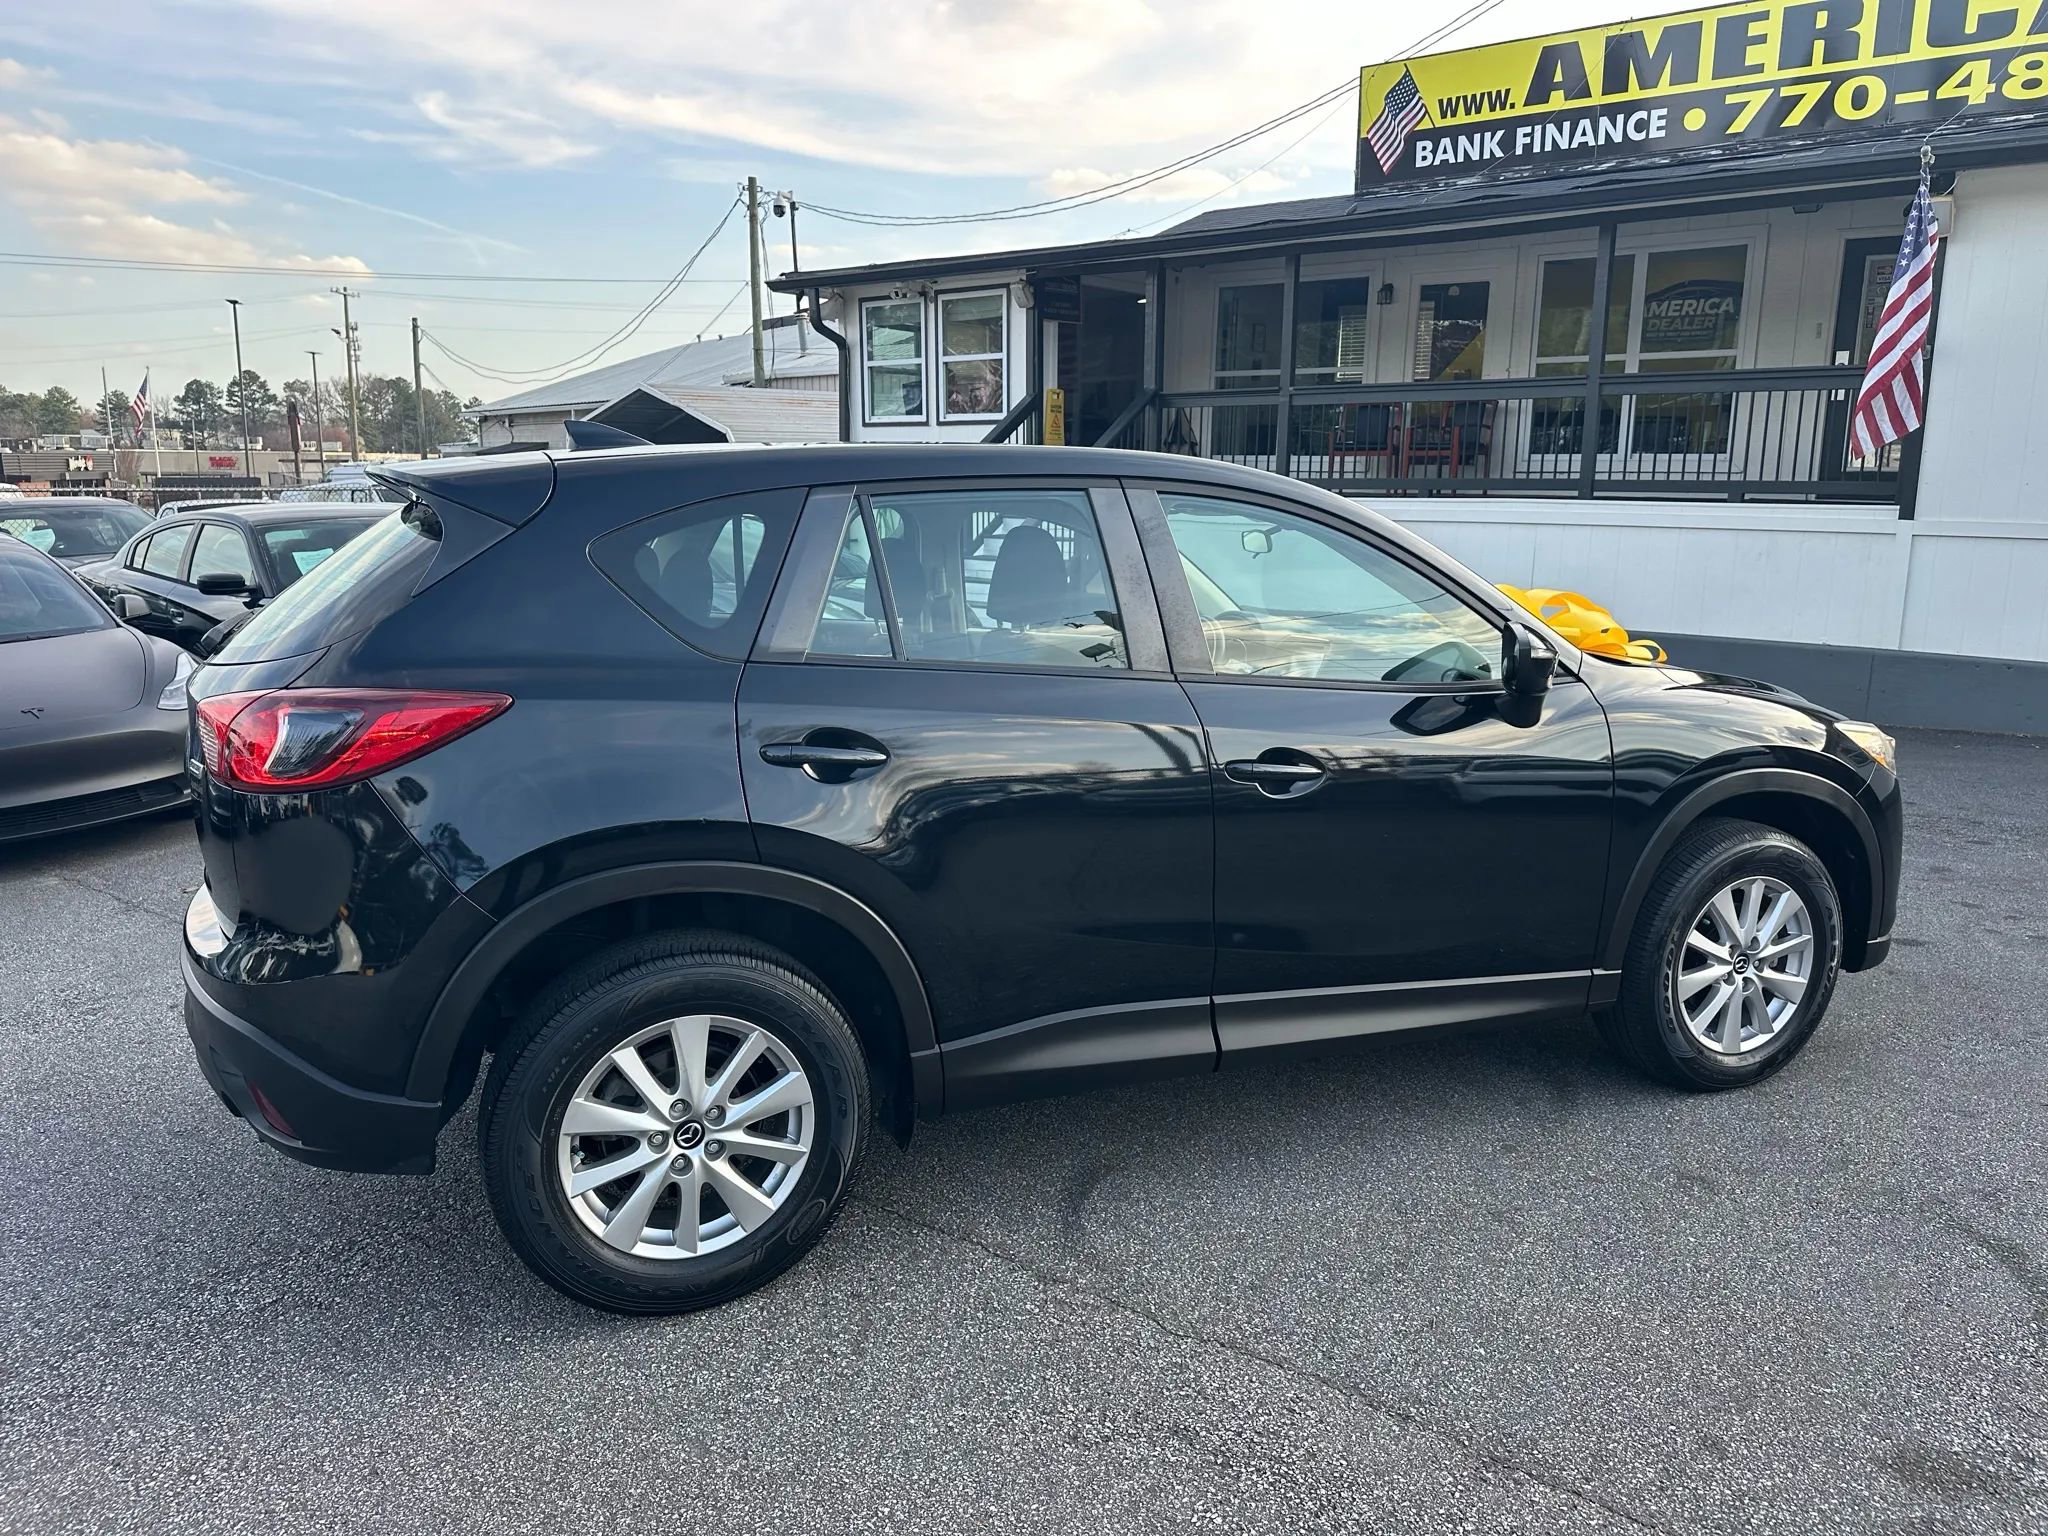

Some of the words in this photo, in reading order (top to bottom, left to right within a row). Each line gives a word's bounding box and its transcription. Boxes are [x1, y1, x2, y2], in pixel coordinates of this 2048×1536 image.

[1523, 0, 2048, 107] AMERIC
[1415, 129, 1506, 168] BANK
[1515, 108, 1668, 155] FINANCE
